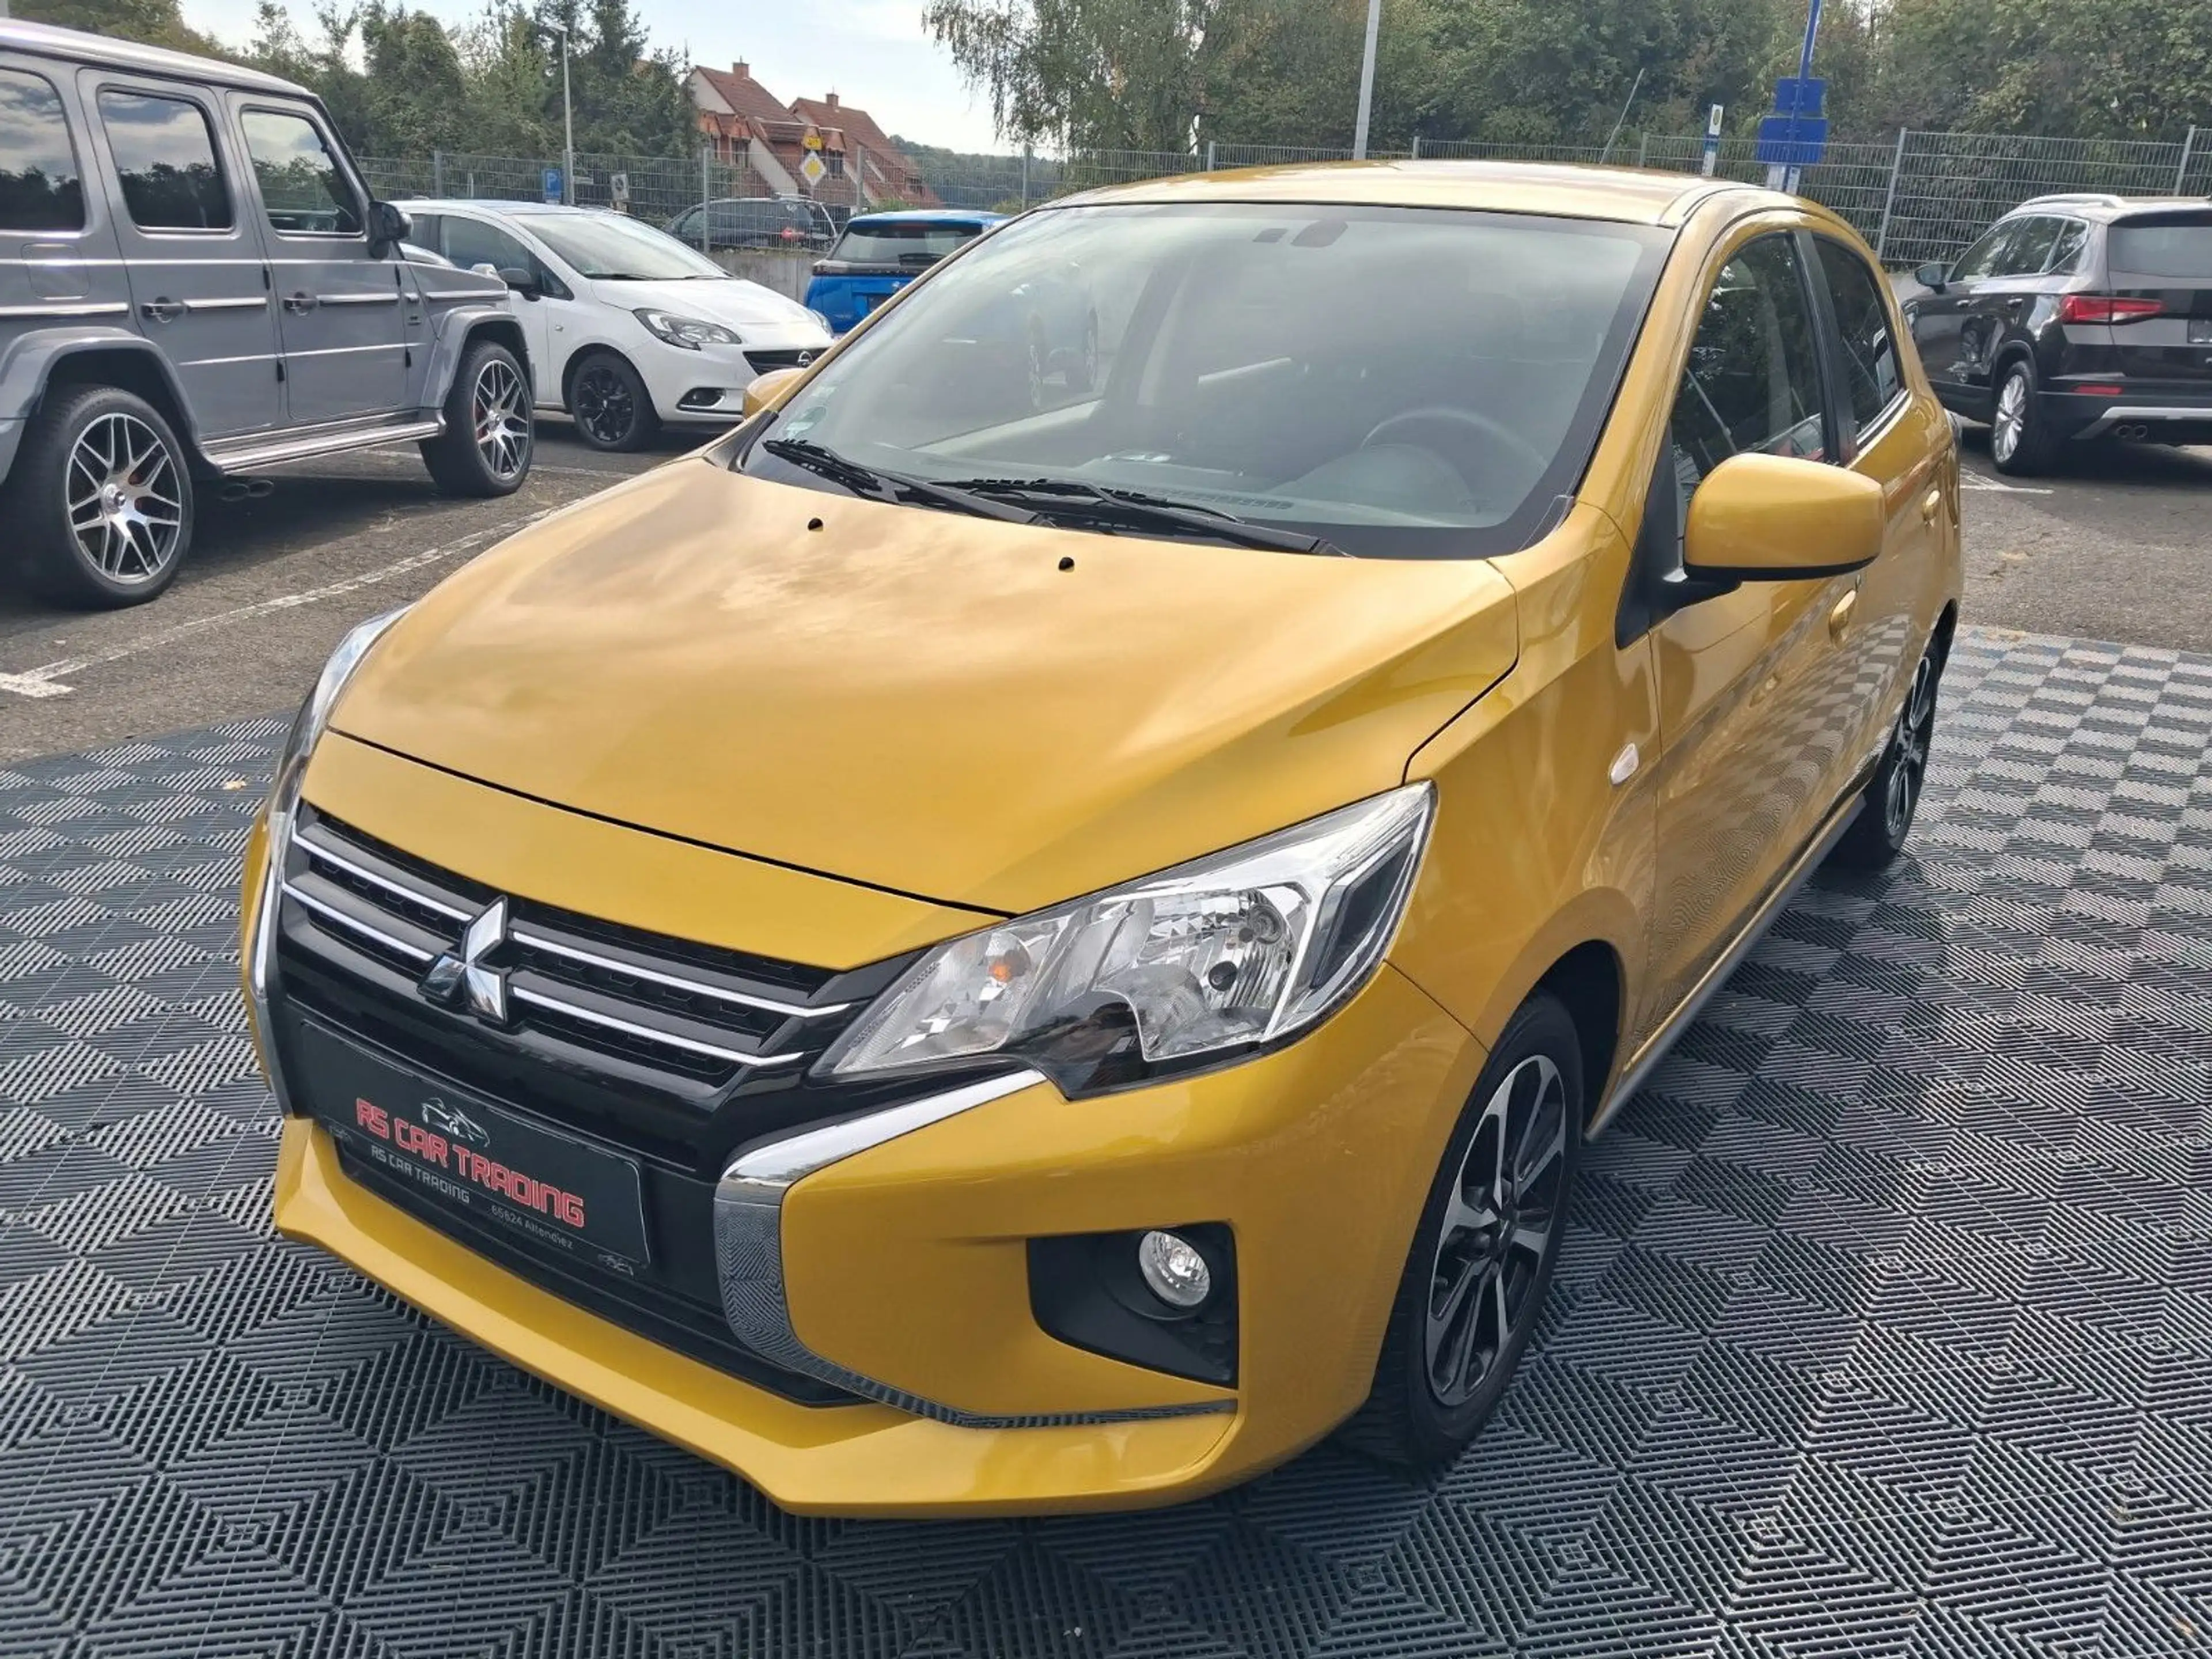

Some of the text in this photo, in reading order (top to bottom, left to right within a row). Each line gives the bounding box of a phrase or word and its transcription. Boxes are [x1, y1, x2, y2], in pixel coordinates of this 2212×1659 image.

[356, 1097, 585, 1228] RS CAR TRADING
[388, 1154, 412, 1176] CAR
